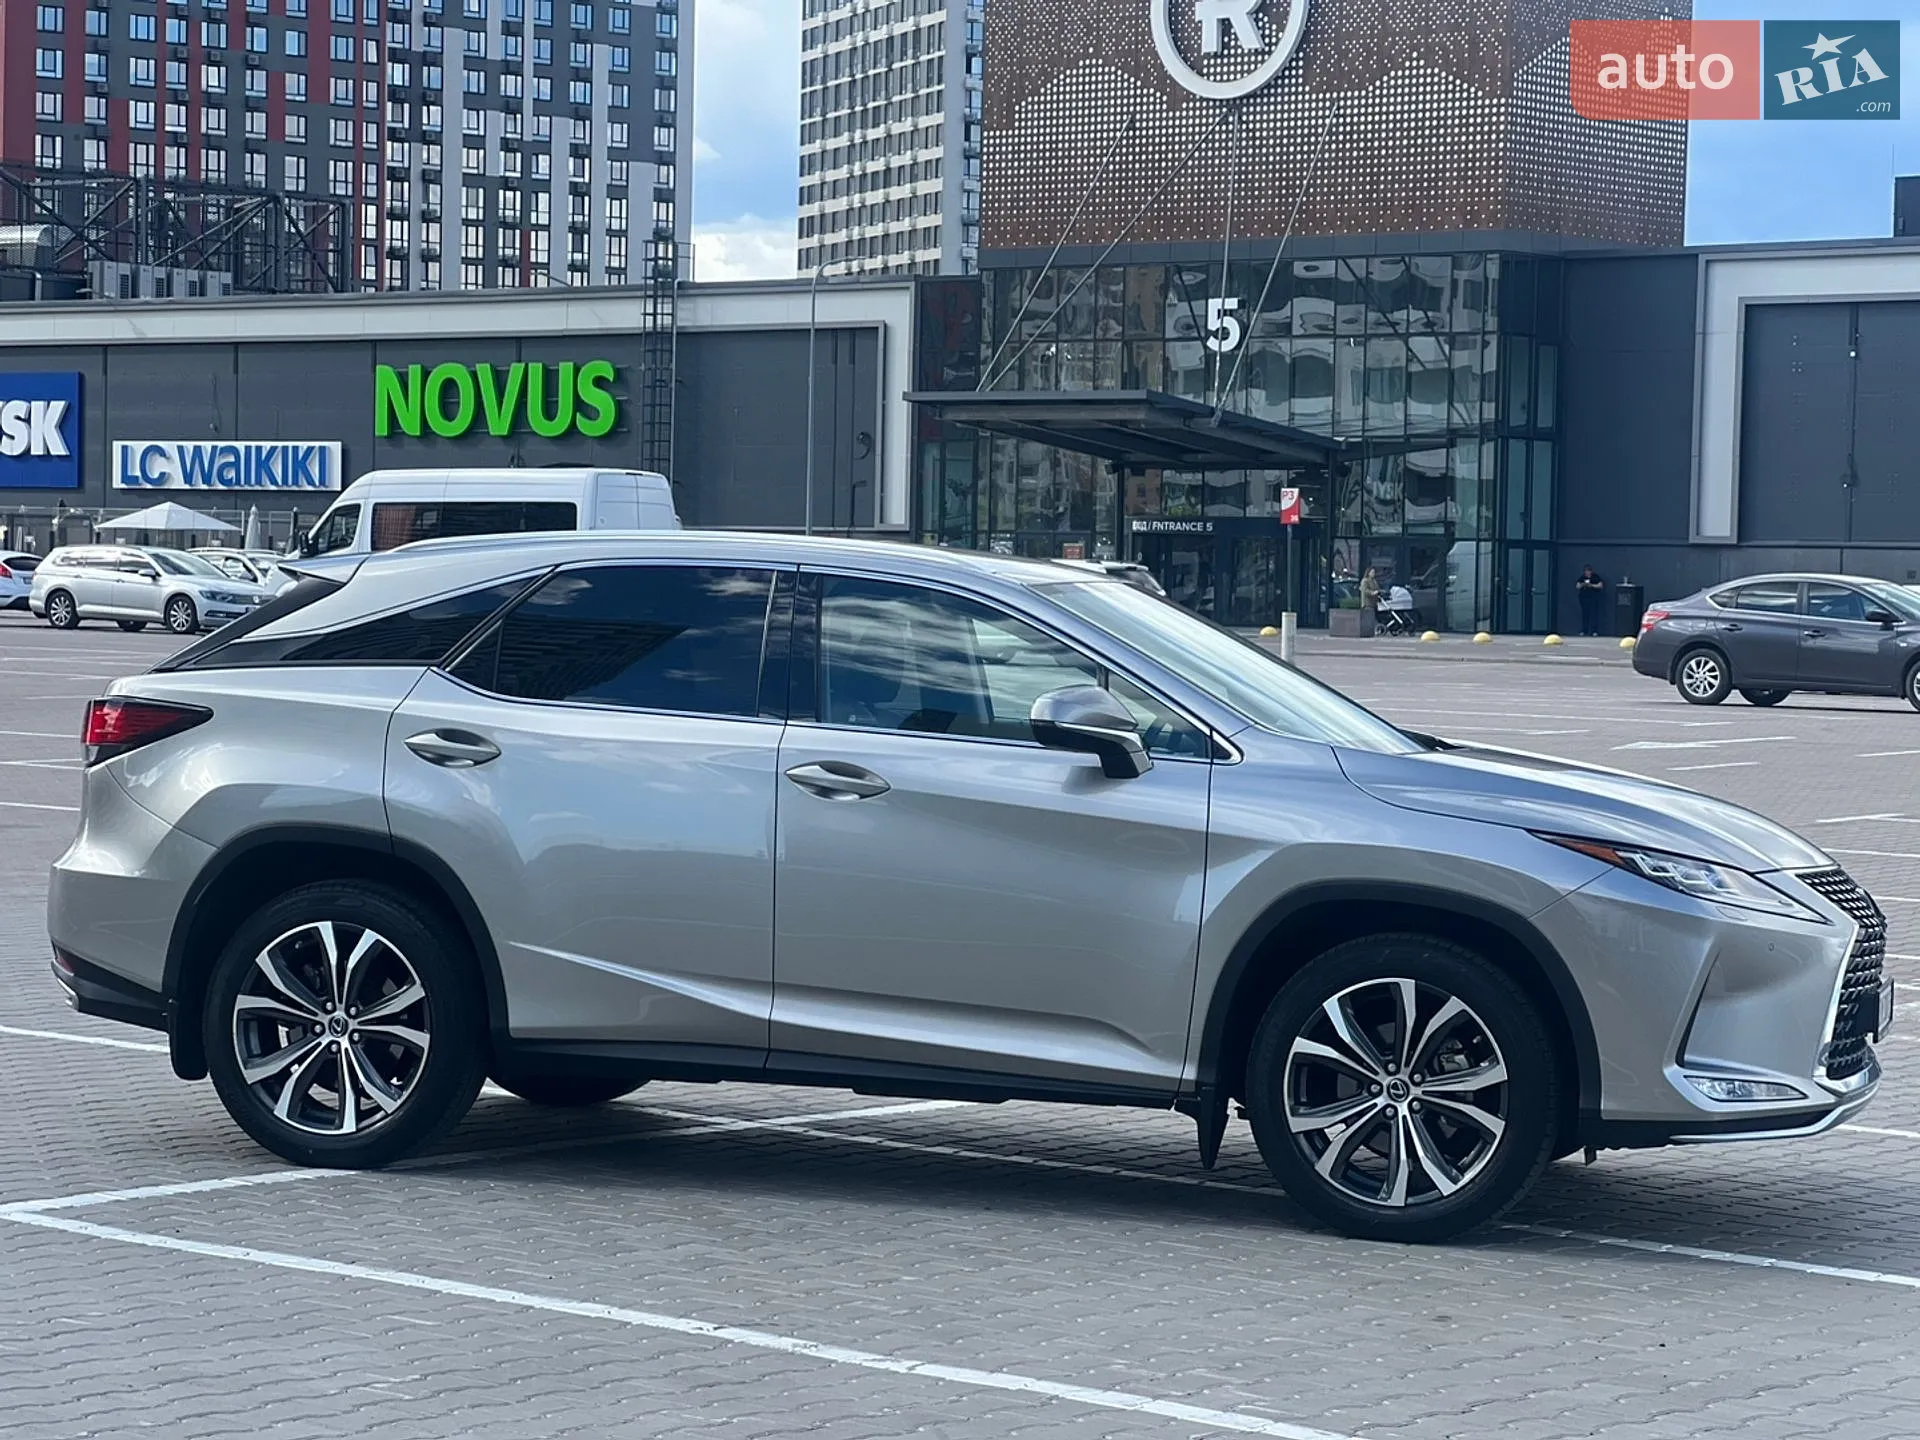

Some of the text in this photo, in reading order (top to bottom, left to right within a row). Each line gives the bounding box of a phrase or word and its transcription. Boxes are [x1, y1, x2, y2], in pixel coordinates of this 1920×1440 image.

[1206, 297, 1241, 353] 5
[374, 360, 616, 438] NOVUS
[0, 399, 70, 456] SK
[120, 444, 169, 486] LC
[1282, 490, 1295, 501] P3
[1205, 522, 1214, 532] 5
